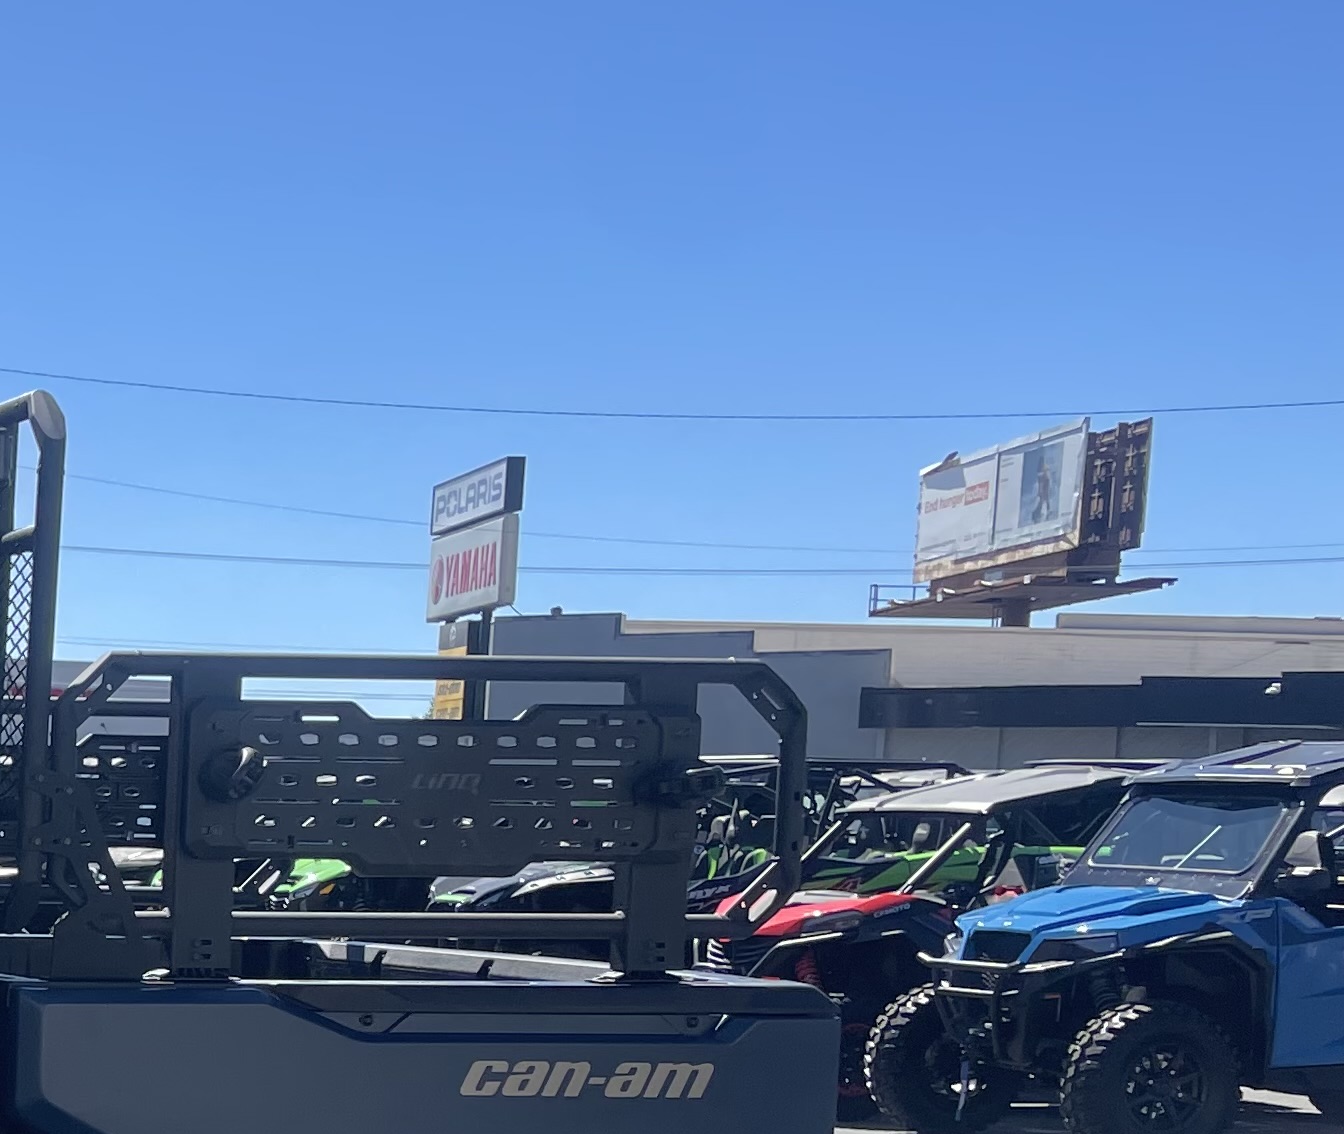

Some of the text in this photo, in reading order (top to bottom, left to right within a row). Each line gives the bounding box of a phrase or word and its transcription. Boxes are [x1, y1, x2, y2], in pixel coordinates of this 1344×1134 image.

[435, 472, 503, 523] POLARIS
[445, 541, 497, 599] YAMAHA
[459, 1060, 715, 1099] can-am
